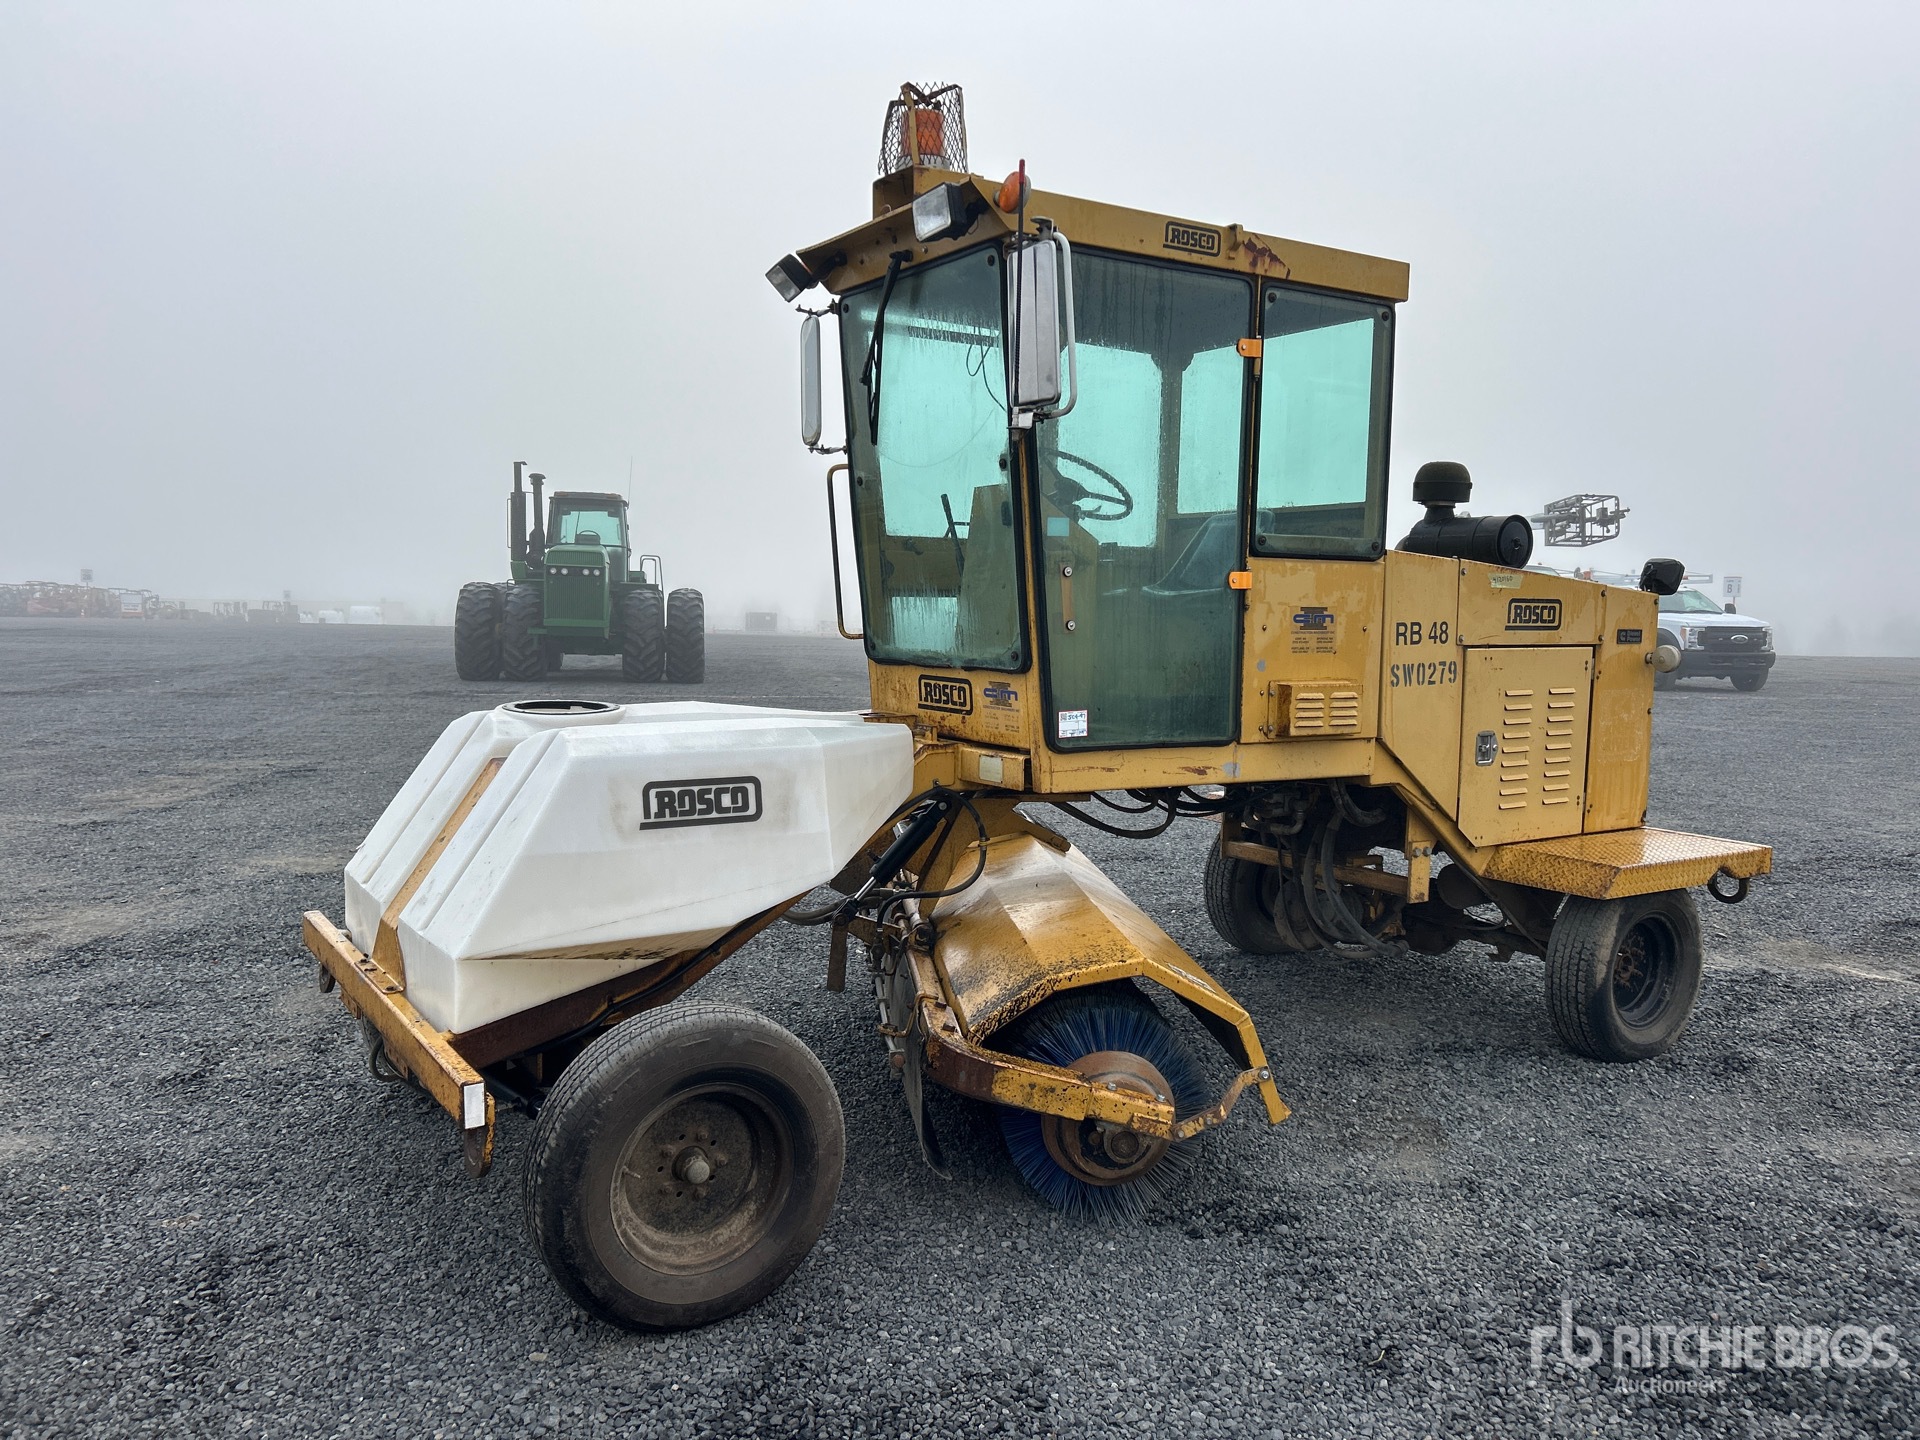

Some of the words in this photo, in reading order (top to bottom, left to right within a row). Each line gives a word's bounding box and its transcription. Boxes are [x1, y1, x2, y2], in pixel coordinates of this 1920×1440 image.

[1169, 227, 1216, 251] ROSCO
[1511, 604, 1557, 624] ROSCO
[1395, 621, 1423, 646] RB
[1428, 620, 1449, 645] 48
[1390, 660, 1458, 688] SW0279
[923, 681, 968, 708] ROSCO
[653, 785, 750, 820] ROSCO
